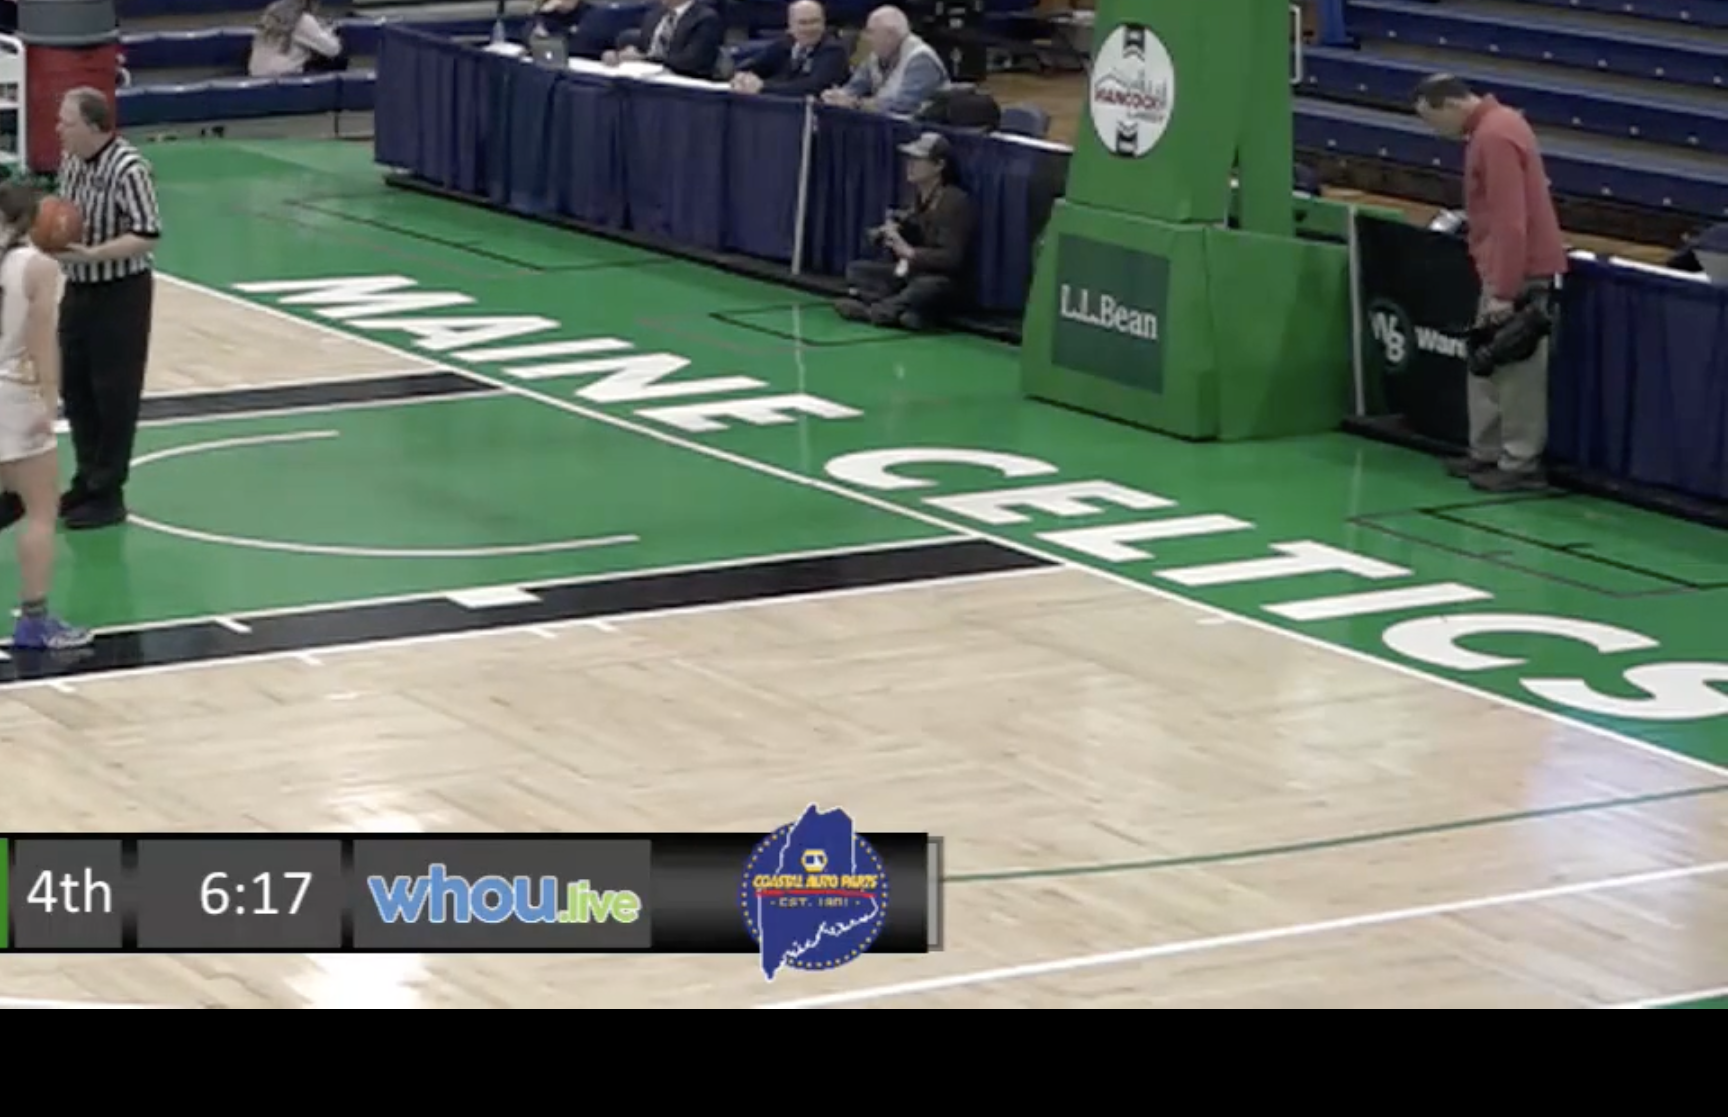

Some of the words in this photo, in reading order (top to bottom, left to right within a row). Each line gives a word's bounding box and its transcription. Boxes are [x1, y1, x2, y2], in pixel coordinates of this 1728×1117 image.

[230, 274, 864, 434] MAINE
[1060, 283, 1158, 340] L.L.Bean
[823, 445, 1728, 722] CELTICS
